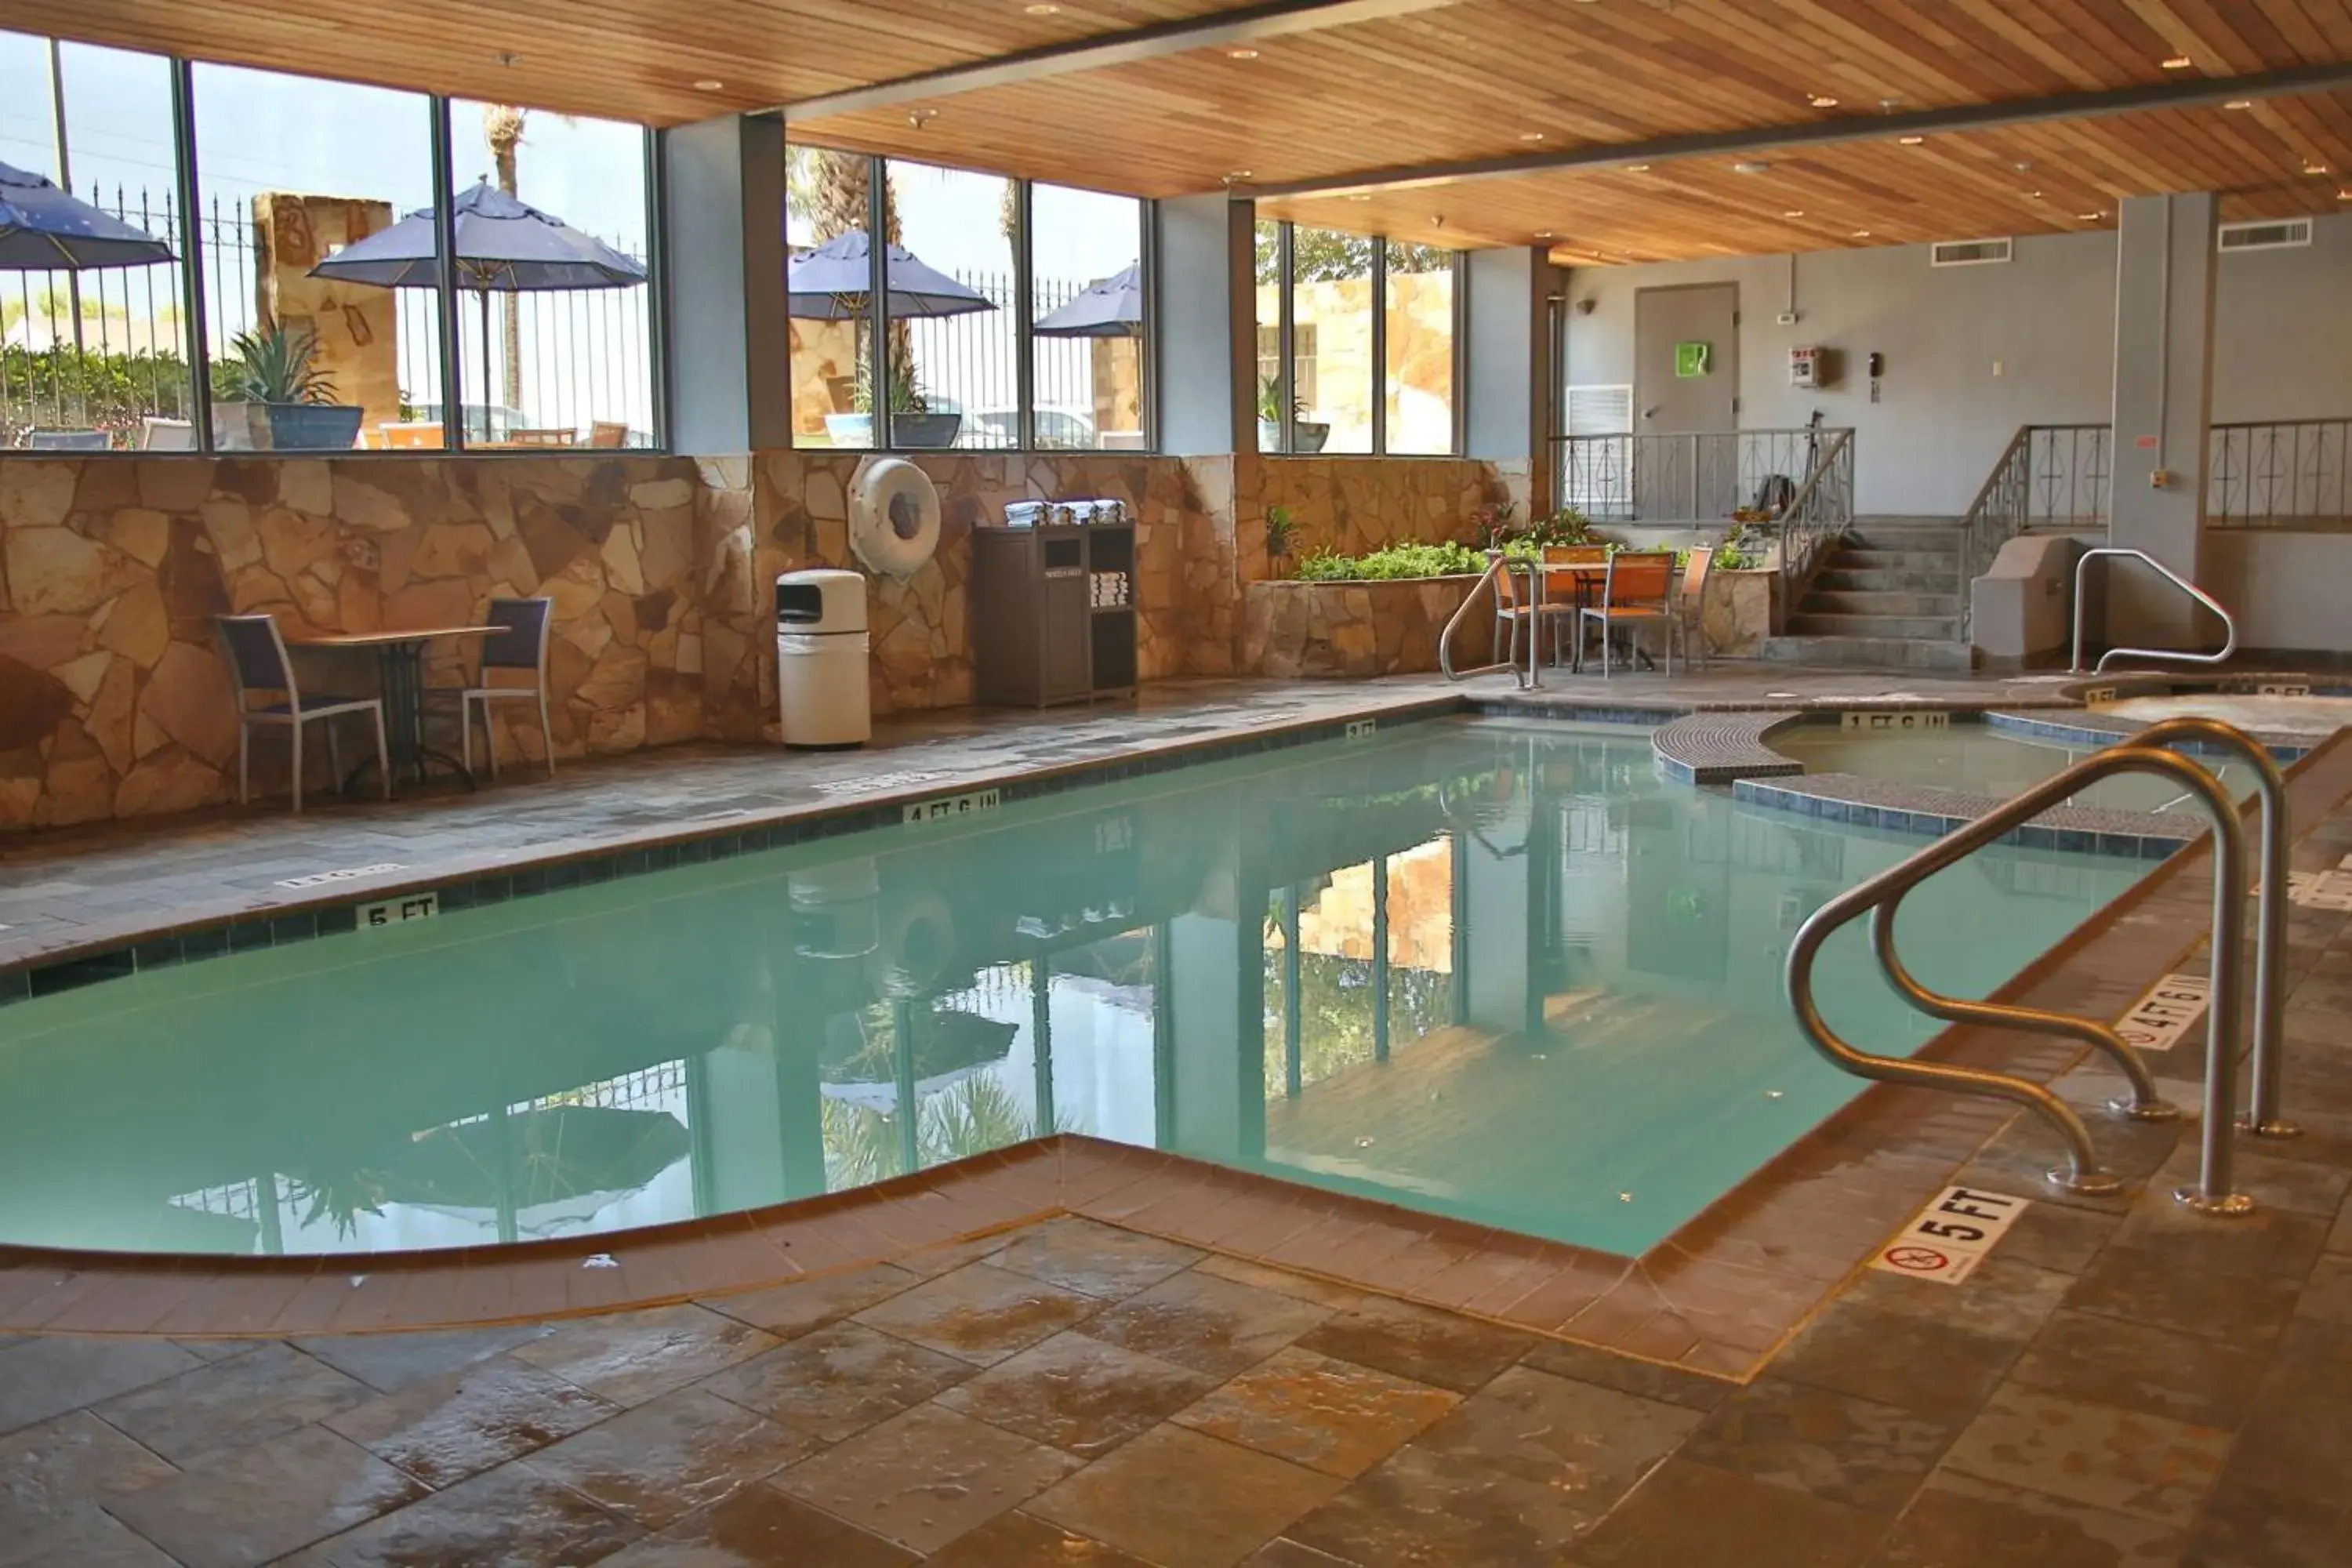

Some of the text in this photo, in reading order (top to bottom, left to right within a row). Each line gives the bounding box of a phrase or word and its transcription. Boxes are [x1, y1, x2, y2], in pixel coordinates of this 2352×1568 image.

[1852, 715, 1859, 726] 1
[1925, 714, 1944, 727] IN
[911, 806, 921, 820] 4
[931, 801, 951, 818] FT
[980, 793, 996, 808] IN
[368, 897, 434, 926] 5 FT
[2158, 991, 2201, 1001] 6
[2140, 1001, 2194, 1018] FT
[2131, 1016, 2179, 1028] 4
[1917, 1189, 2013, 1241] 5 FT
